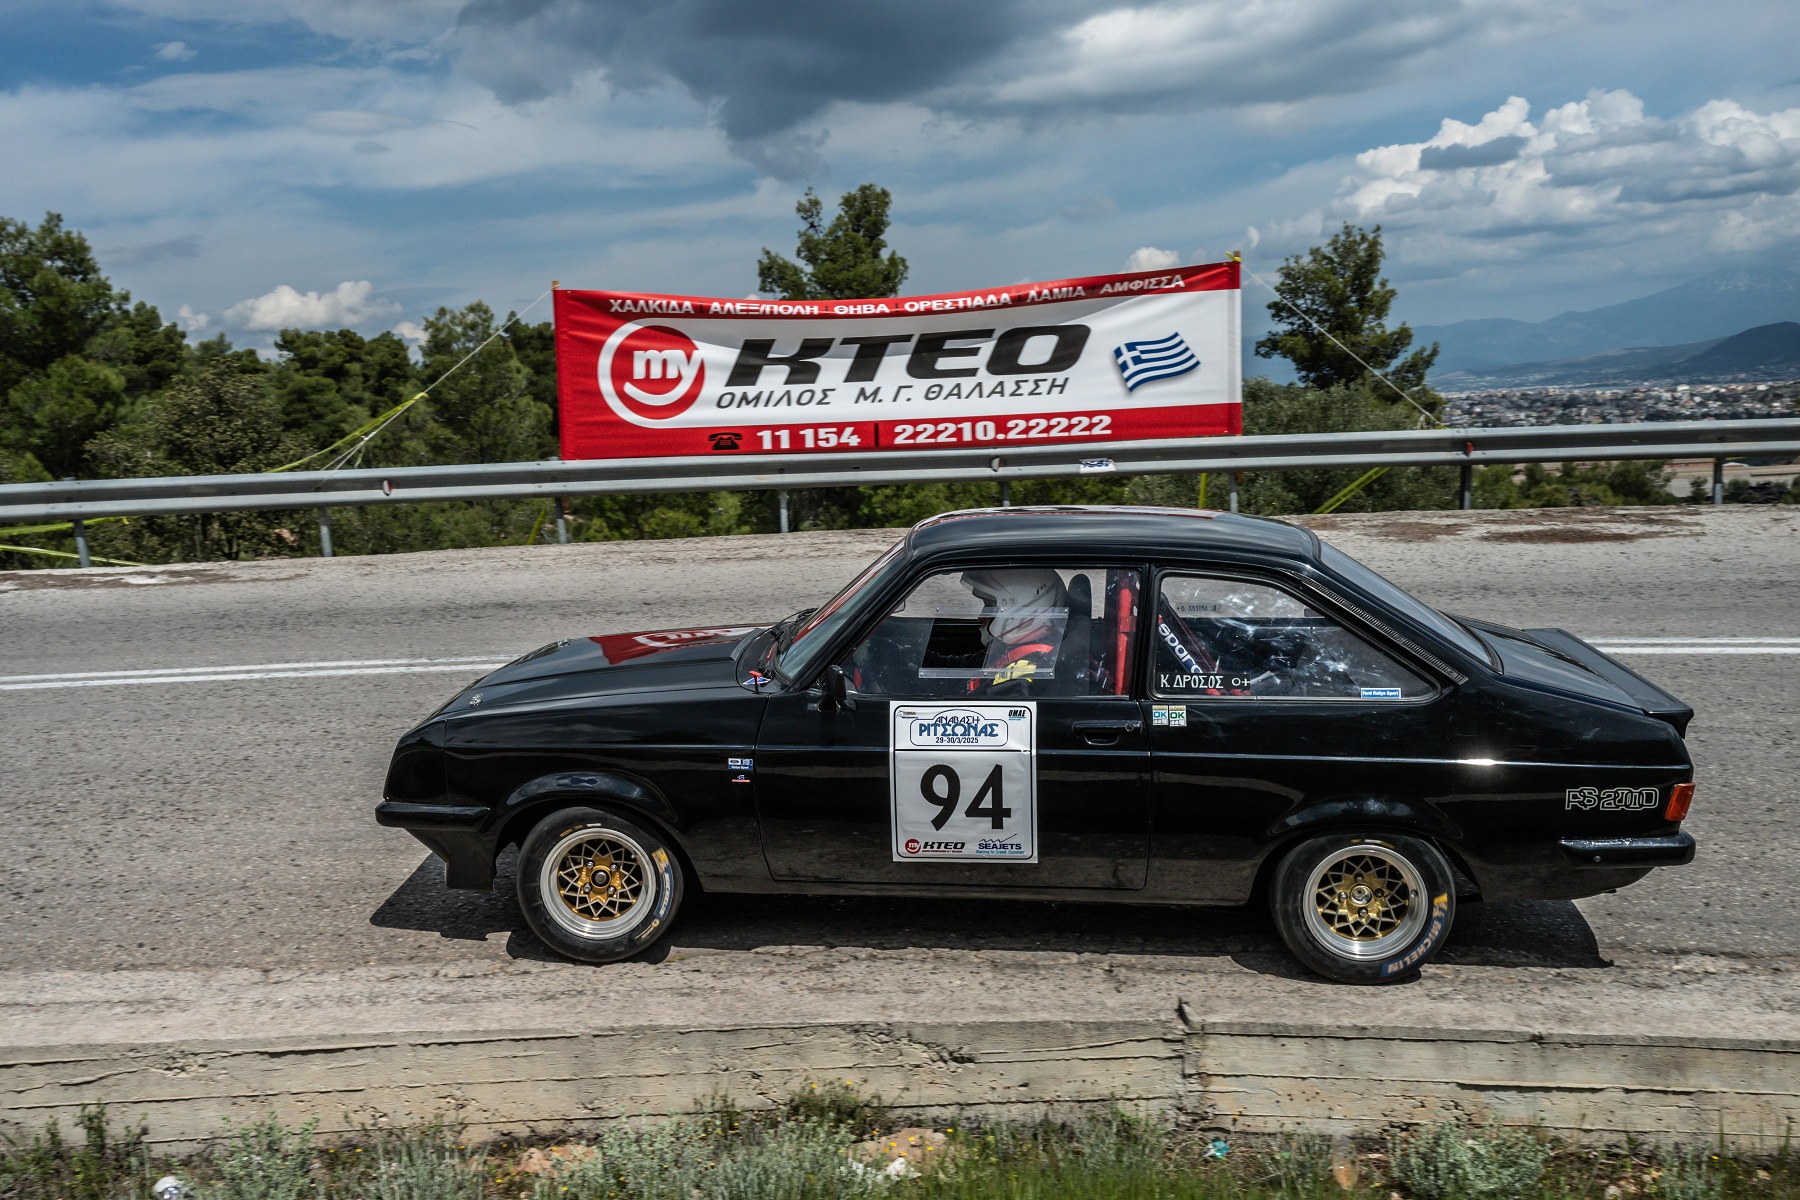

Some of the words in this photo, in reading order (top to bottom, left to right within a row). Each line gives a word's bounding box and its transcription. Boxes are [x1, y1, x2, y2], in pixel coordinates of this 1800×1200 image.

[608, 299, 695, 314] ΧΑΛΚΙΔΑ
[708, 301, 819, 315] ΑΛΕΞ/ΠΟΛΗ
[833, 303, 891, 315] ΘΗΒΑ
[903, 292, 1013, 312] ΟΡΕΣΤΙΑΔΑ
[1026, 285, 1086, 303] ΛΑΜΙΑ
[1100, 274, 1186, 294] ΑΜΦΙΣΣΑ
[632, 348, 704, 381] my
[725, 324, 1091, 387] ΚΤΕΟ
[715, 388, 837, 409] ΟΜΙΛΟΣ
[854, 386, 883, 404] Μ.
[891, 385, 914, 402] Γ.
[923, 377, 1070, 401] ΘΑΛΑΣΣΗ
[757, 429, 791, 450] 11
[799, 427, 862, 448] 154
[893, 415, 1112, 445] 22210.22222
[1158, 623, 1203, 674] sparc
[1173, 674, 1224, 689] ΔΡΟΣΟΣ
[935, 715, 981, 724] ΑΝΑΒΑΣΗ
[1153, 711, 1167, 719] OK
[1170, 711, 1185, 719] OK
[918, 722, 999, 738] ΡΙΤΣΩΝΑΣ
[935, 736, 979, 744] 29-30/3/2025
[919, 763, 1012, 832] 94
[1564, 786, 1599, 811] RS
